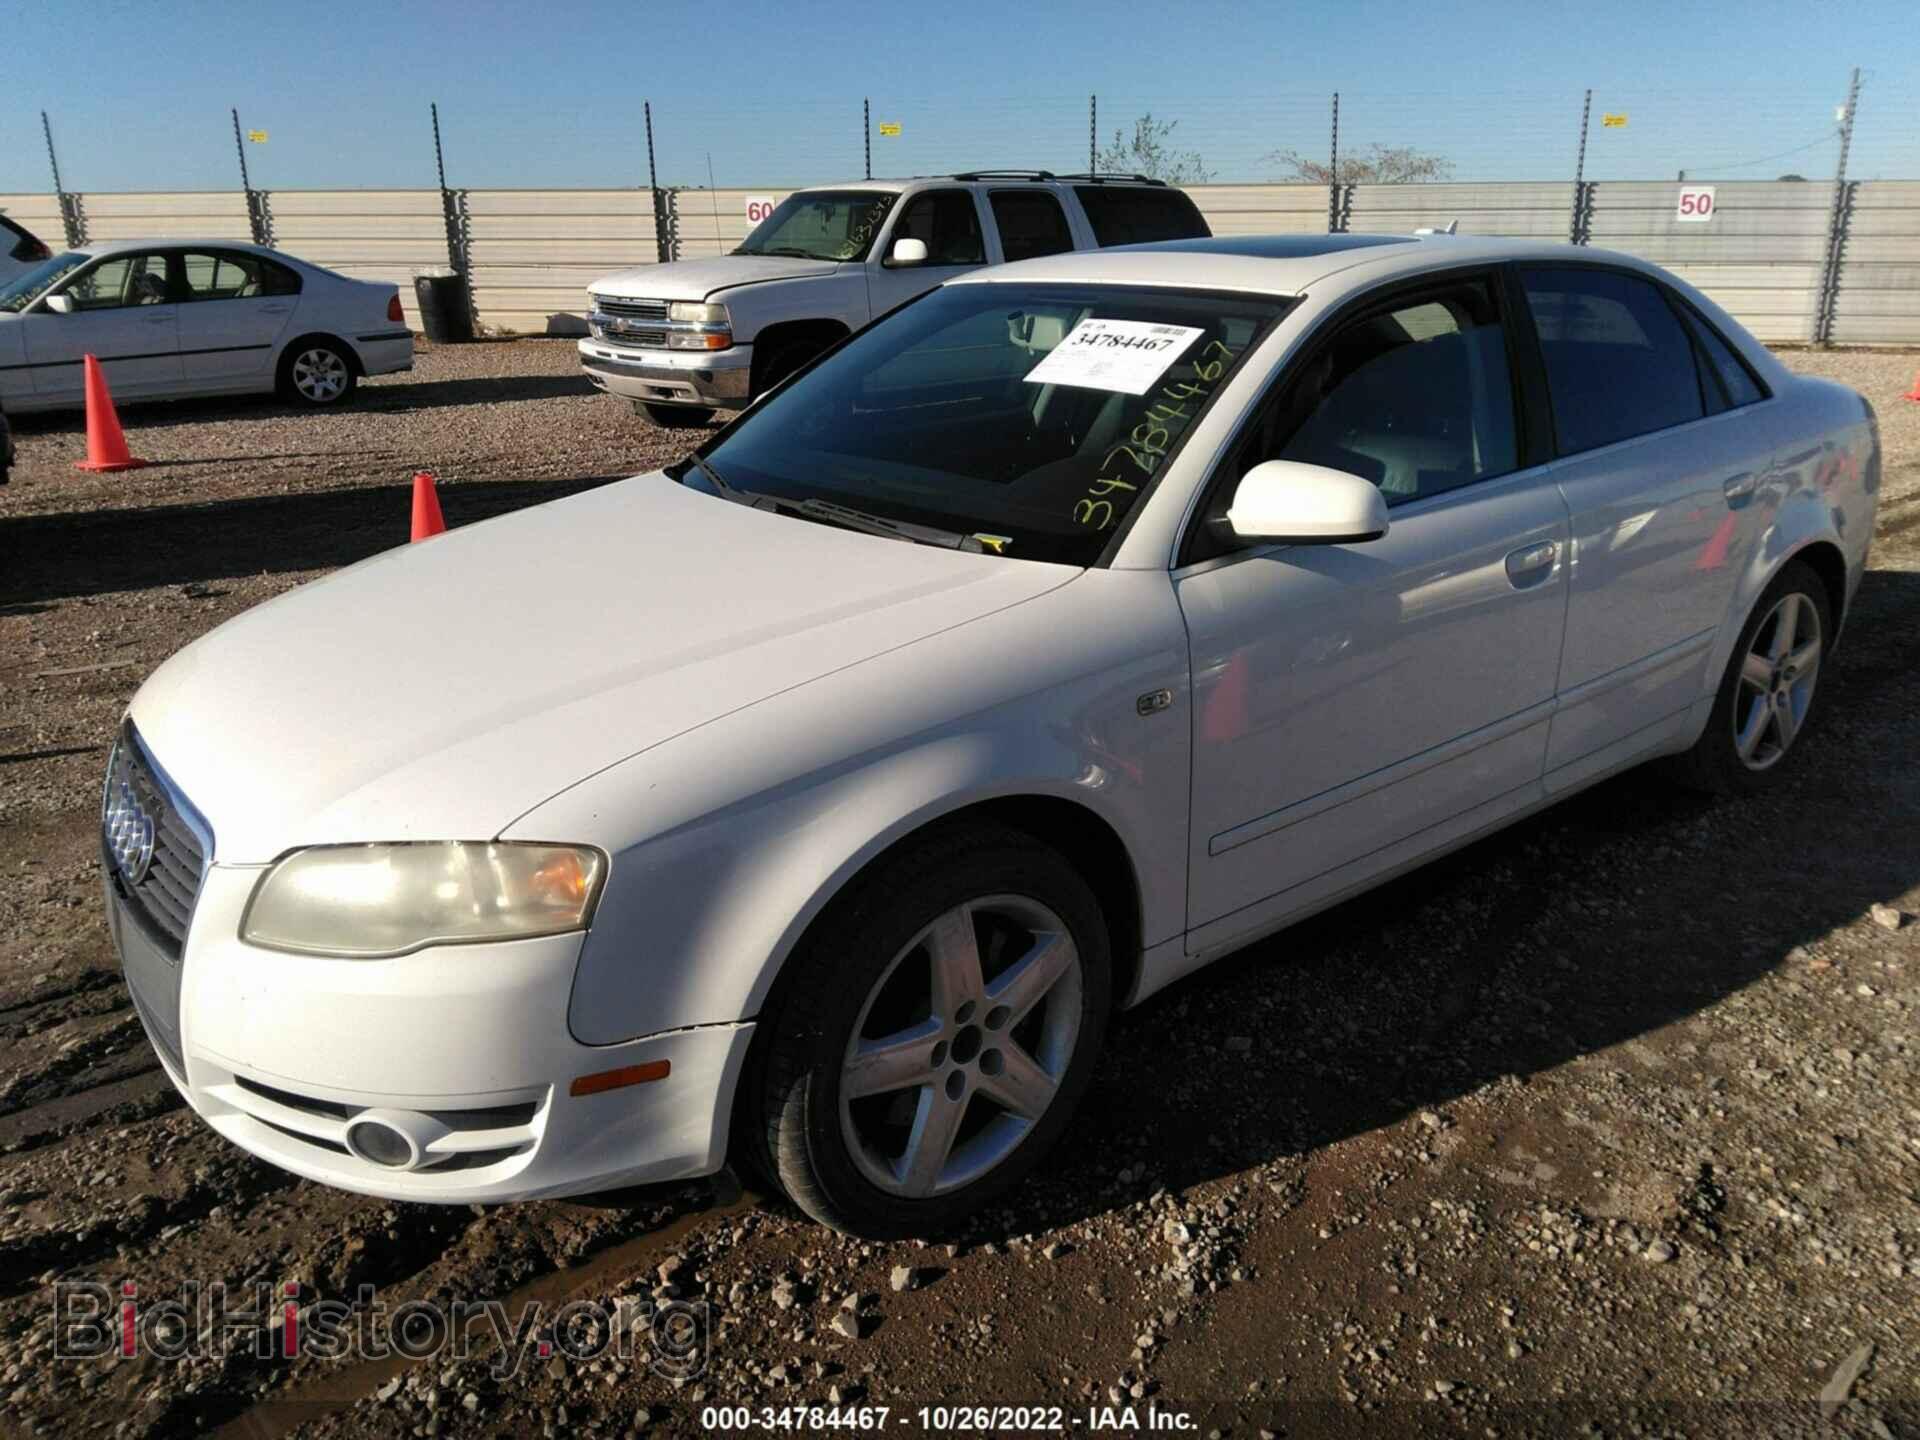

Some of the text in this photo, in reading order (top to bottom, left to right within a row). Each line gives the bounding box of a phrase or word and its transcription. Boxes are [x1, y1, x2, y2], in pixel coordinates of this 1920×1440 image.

[748, 202, 774, 221] 60
[1680, 193, 1712, 215] 50
[1072, 332, 1174, 351] 34784467
[1073, 340, 1234, 530] 34784467
